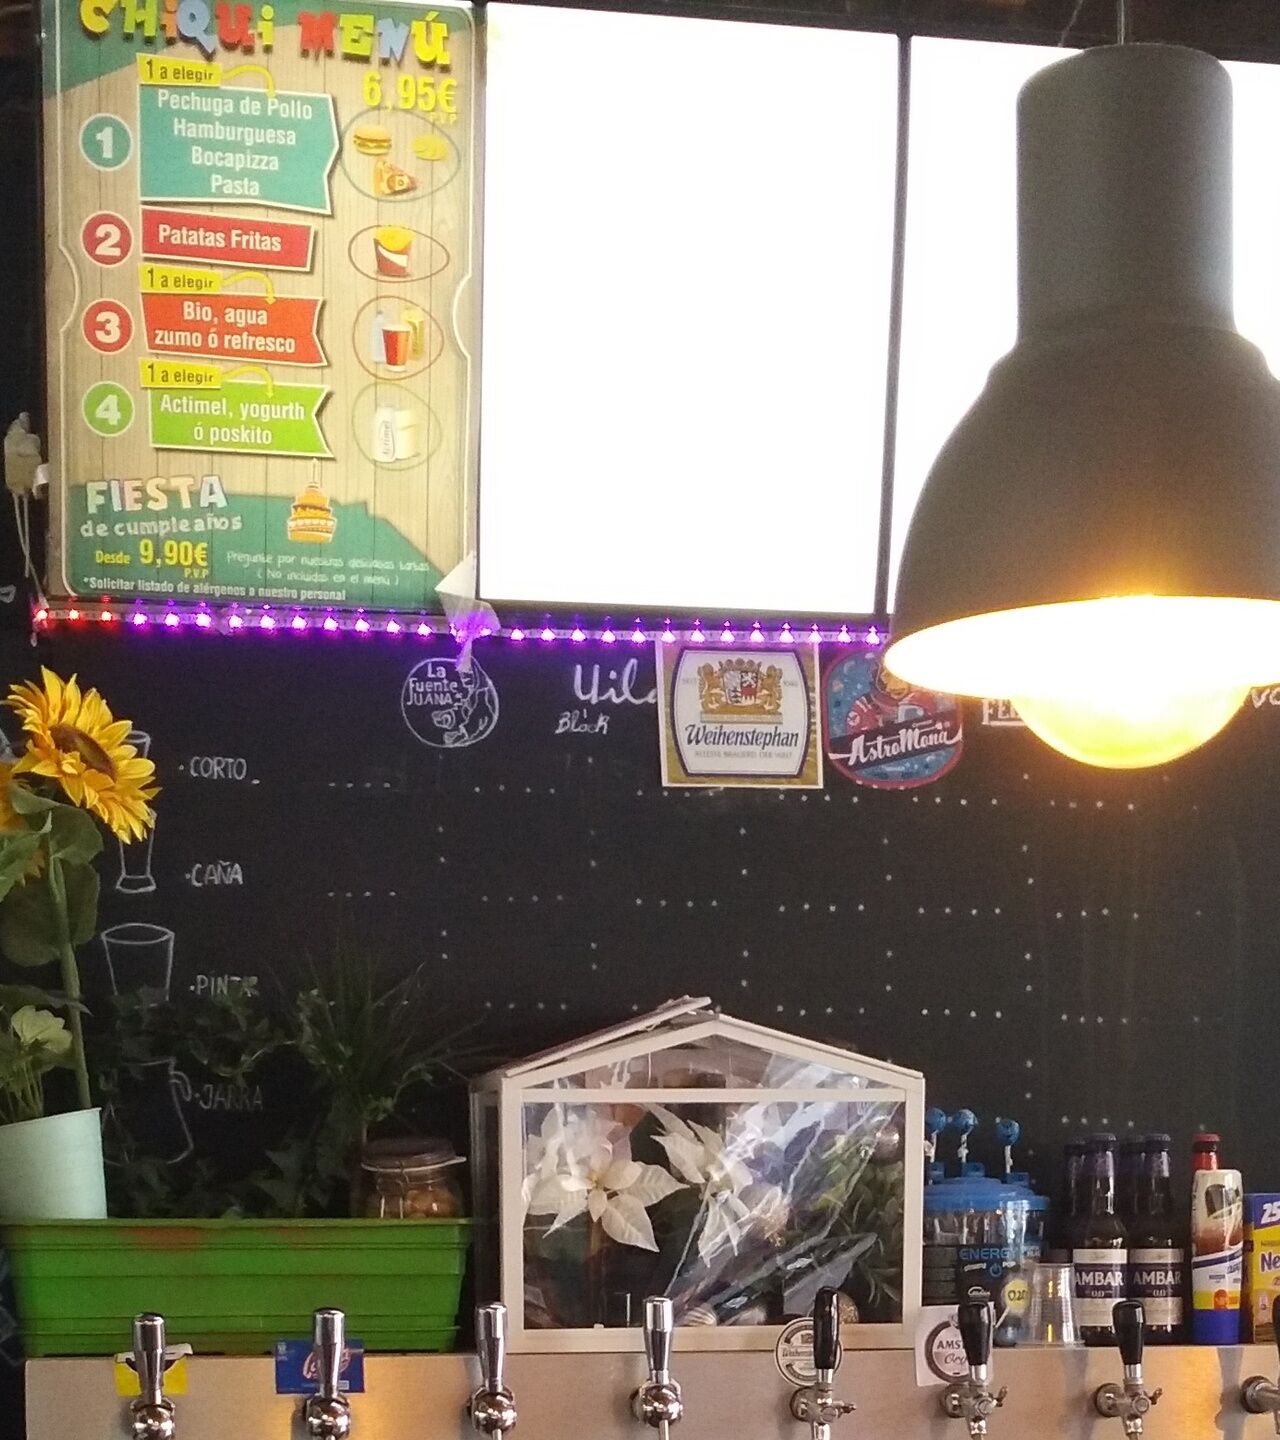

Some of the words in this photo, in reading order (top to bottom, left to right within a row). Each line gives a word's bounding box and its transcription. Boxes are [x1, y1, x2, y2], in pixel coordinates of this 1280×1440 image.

[298, 10, 452, 70] MENÚ
[146, 59, 154, 77] 1
[159, 65, 169, 79] a
[173, 65, 214, 82] elegir
[158, 89, 235, 118] Pechuga
[240, 95, 262, 115] de
[267, 98, 312, 120] Pollo
[95, 127, 114, 159] 1
[173, 118, 296, 147] Hamburguesa
[191, 146, 279, 172] Bocapizza
[211, 175, 260, 197] Pasta
[95, 224, 122, 257] 2
[158, 225, 225, 248] Patatas
[231, 229, 281, 251] Fritas
[146, 267, 154, 286] 1
[159, 274, 169, 288] a
[173, 273, 214, 291] elegir
[95, 310, 122, 343] 3
[183, 301, 217, 324] Bio,
[224, 307, 268, 328] agua
[154, 331, 201, 348] zumo
[207, 328, 218, 348] ó
[224, 331, 296, 353] refresco
[146, 364, 154, 382] 1
[159, 370, 169, 383] a
[173, 368, 214, 385] elegir
[95, 394, 122, 425] 4
[160, 394, 234, 416] Actimel,
[240, 400, 305, 424] yogurth
[193, 422, 204, 441] ó
[210, 425, 272, 446] poskito
[86, 476, 228, 514] FIESTA
[80, 520, 109, 537] de
[113, 513, 242, 537] cumpleaños
[95, 550, 131, 565] Desde
[139, 538, 209, 568] 9,90€
[277, 555, 296, 567] por
[138, 578, 174, 593] listado
[177, 580, 190, 594] de
[193, 582, 246, 598] alérgenos
[258, 586, 298, 599] nuestro
[300, 588, 346, 601] personal
[427, 663, 446, 678] La
[408, 678, 458, 693] Fuente
[406, 692, 453, 707] JUANA
[685, 723, 799, 751] Weihenstephan
[844, 723, 961, 767] AstroMona
[190, 757, 247, 781] CORTO
[191, 860, 243, 887] CAÑA
[1075, 1271, 1124, 1286] AMBAR
[1133, 1270, 1181, 1286] AMBAR
